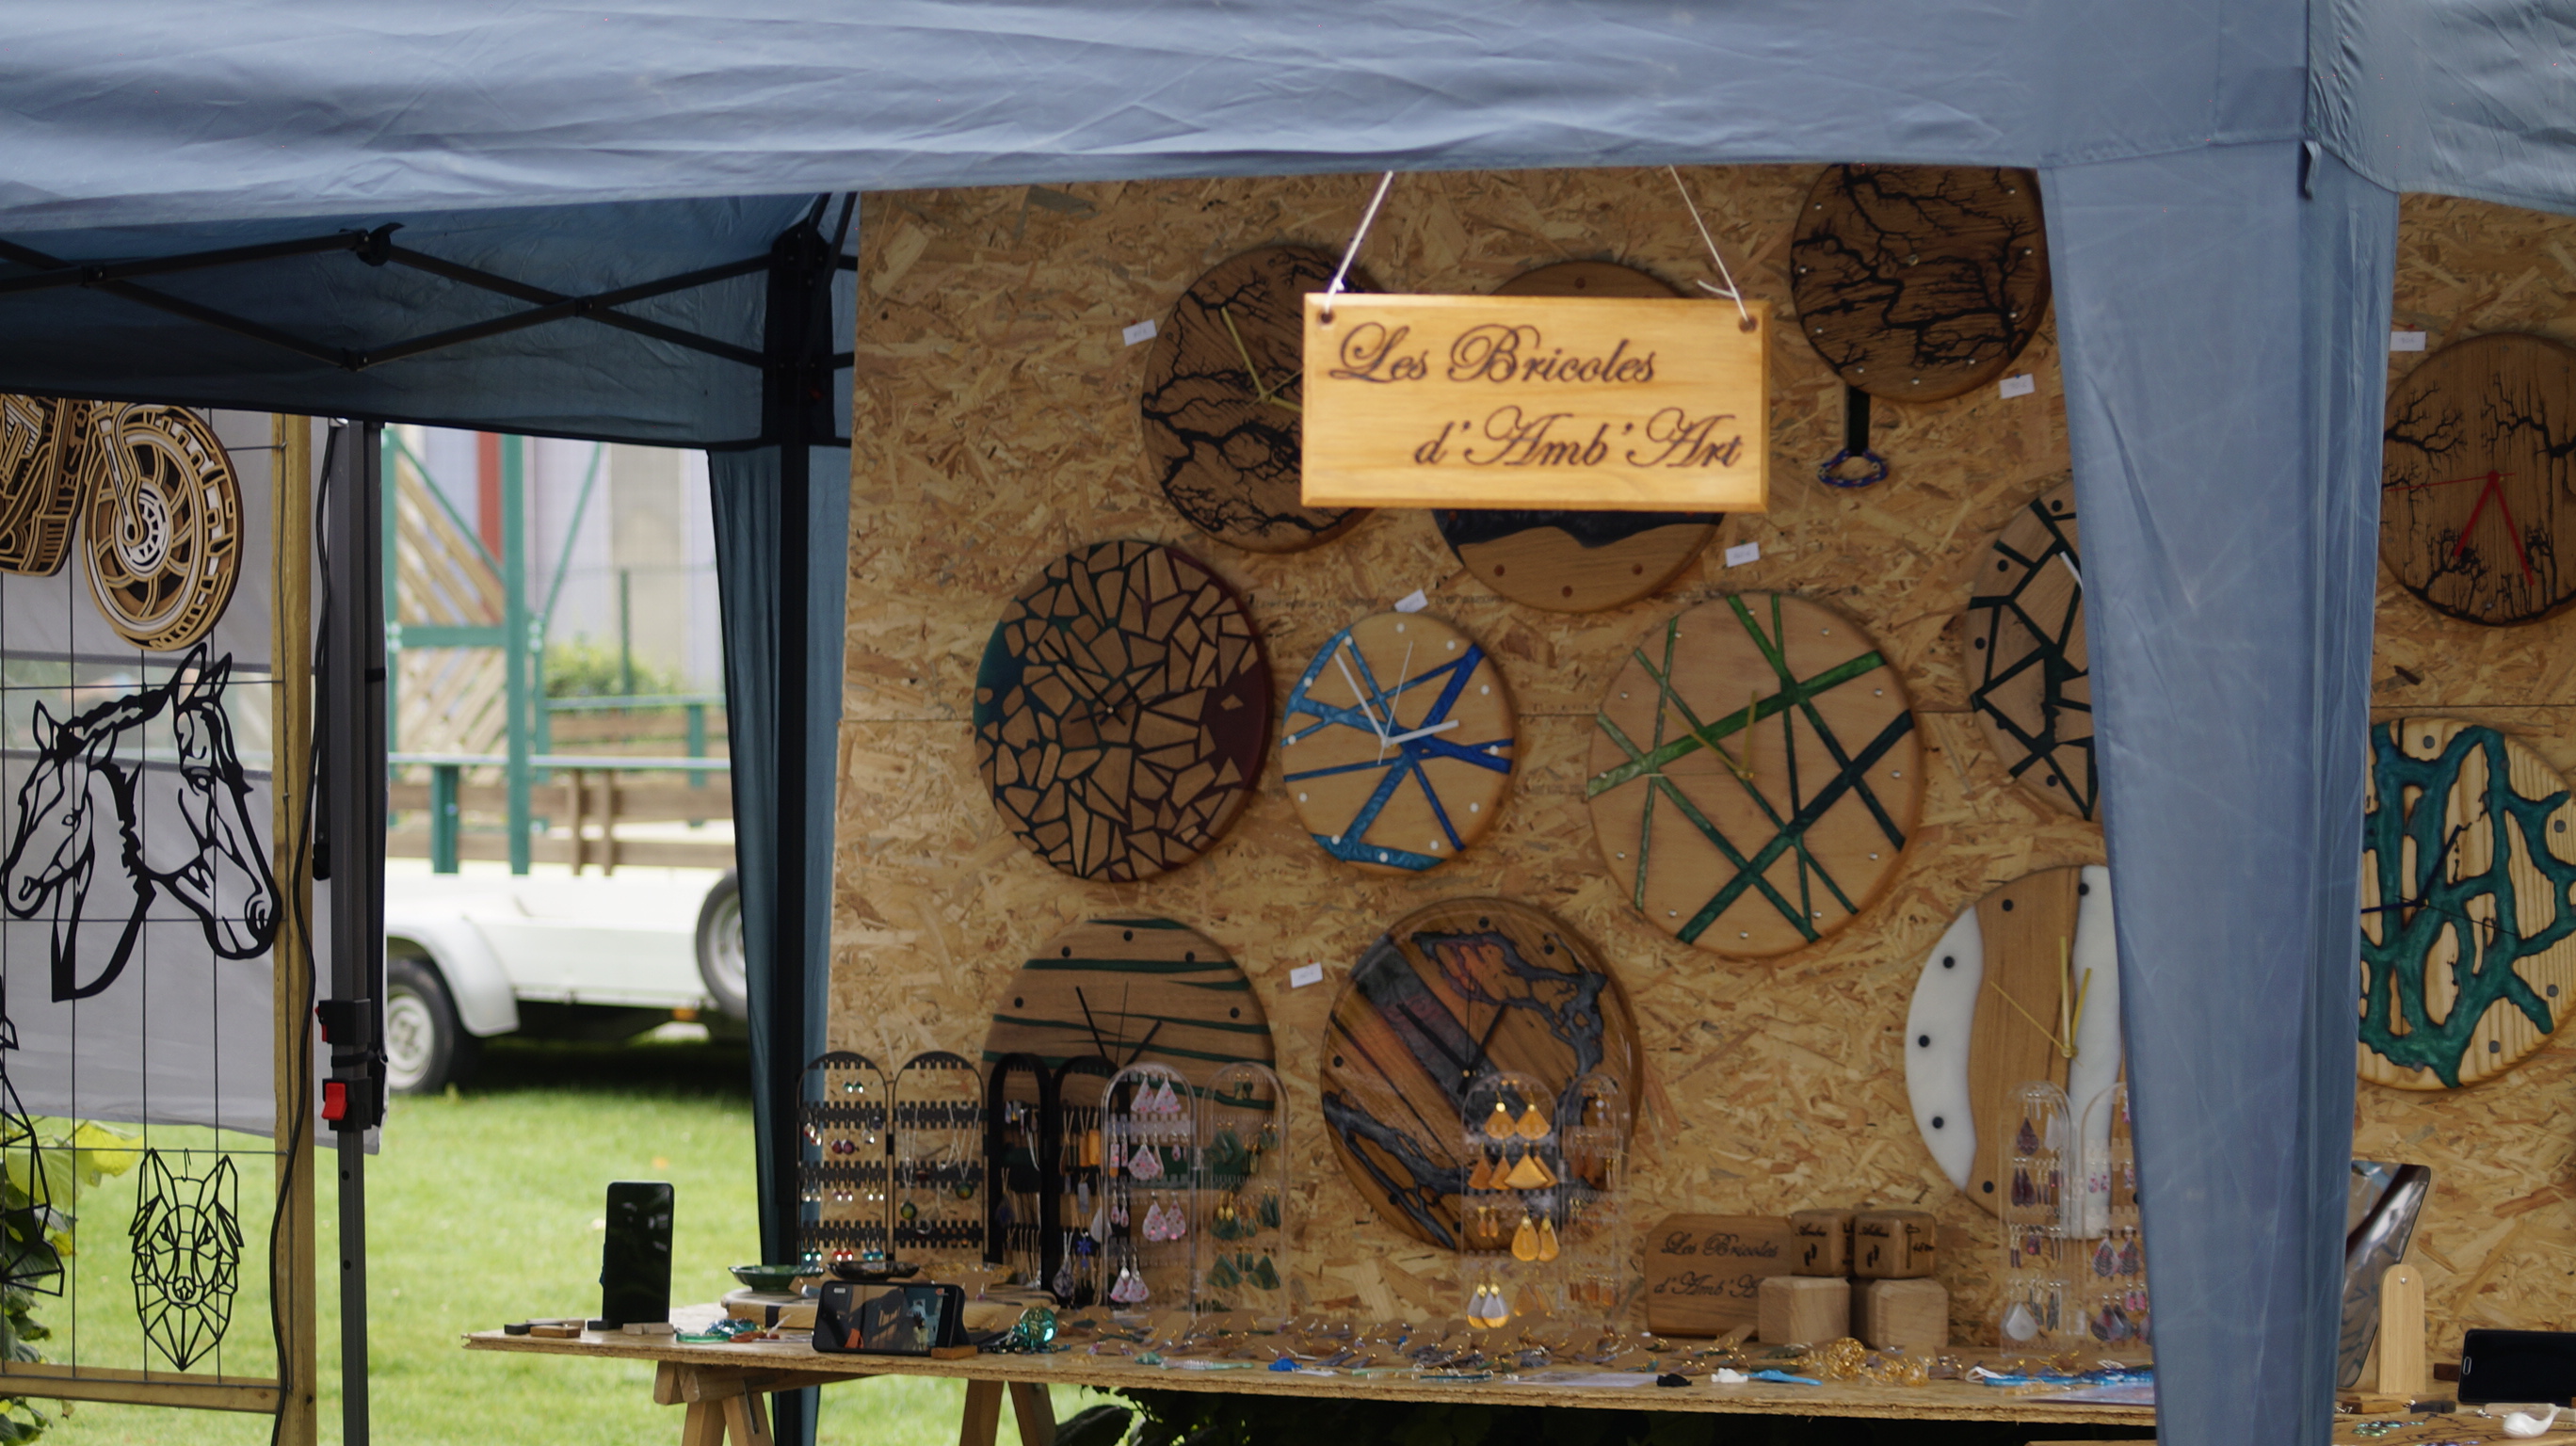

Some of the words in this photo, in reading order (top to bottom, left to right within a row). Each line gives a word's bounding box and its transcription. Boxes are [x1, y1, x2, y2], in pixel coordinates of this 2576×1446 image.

[1328, 321, 1429, 383] Les
[1447, 323, 1656, 383] Bricoles
[1415, 405, 1745, 469] d'Amb'Art
[1661, 1230, 1698, 1255] Les
[1702, 1232, 1779, 1258] Bricoles
[1653, 1270, 1765, 1298] d'Amb'A
